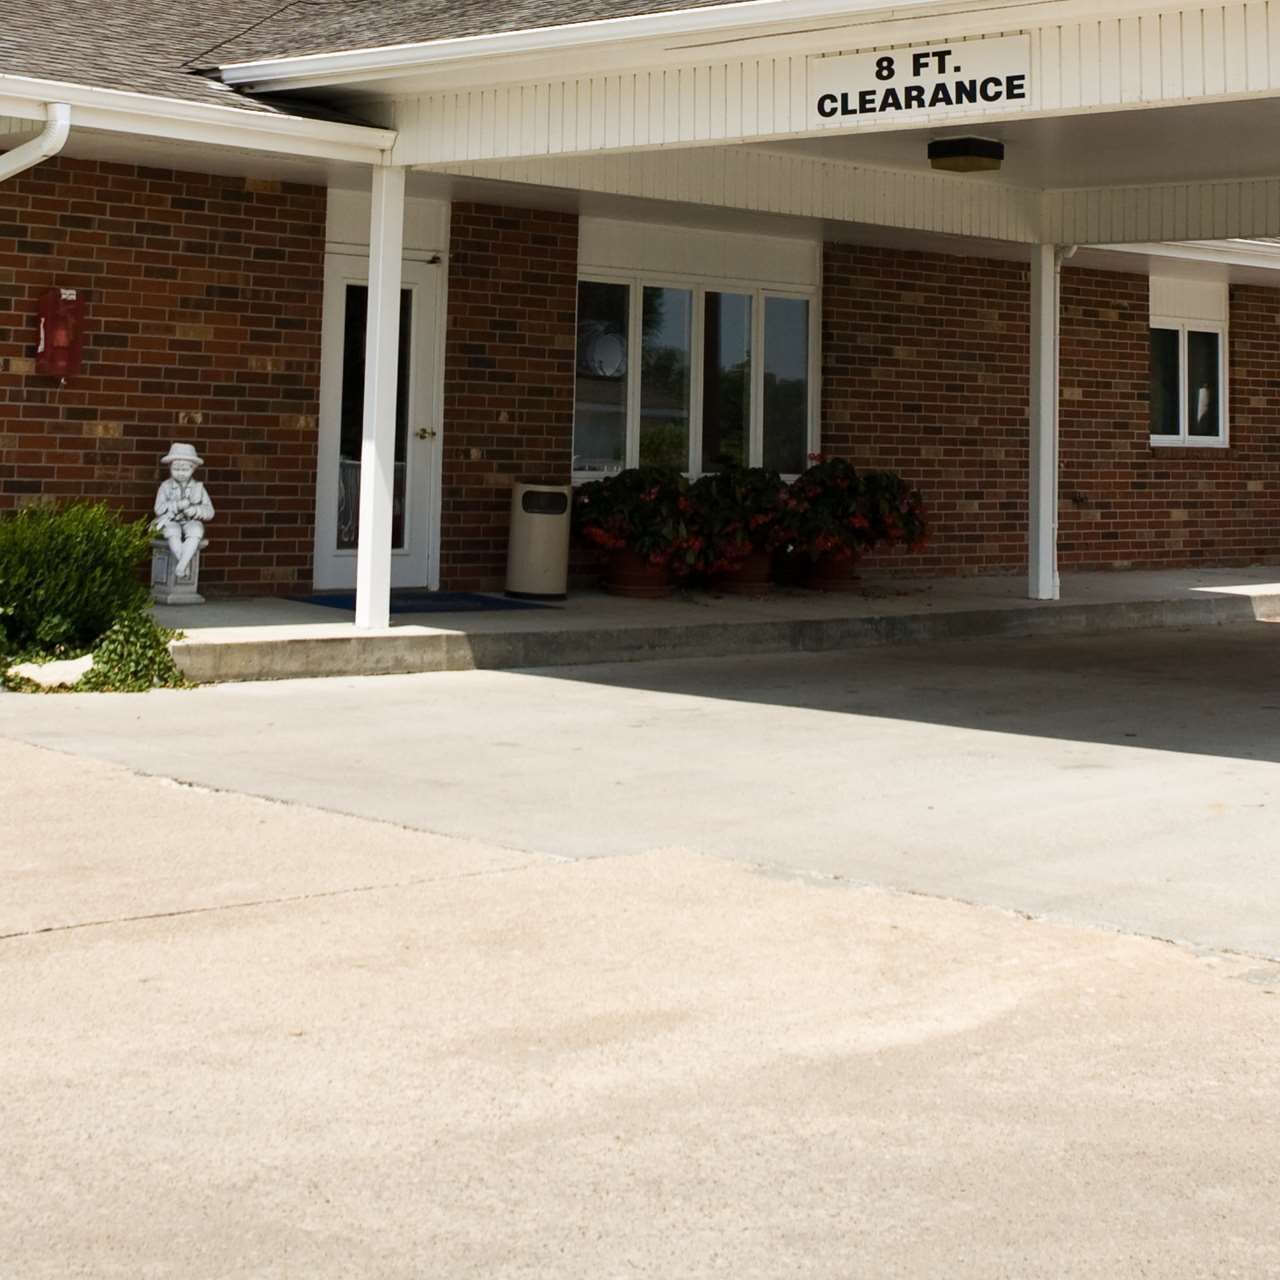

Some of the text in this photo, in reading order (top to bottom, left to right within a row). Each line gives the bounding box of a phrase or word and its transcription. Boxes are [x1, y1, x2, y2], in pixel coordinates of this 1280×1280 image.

[875, 50, 961, 80] 8 FT.
[817, 74, 1025, 117] CLEARANCE
